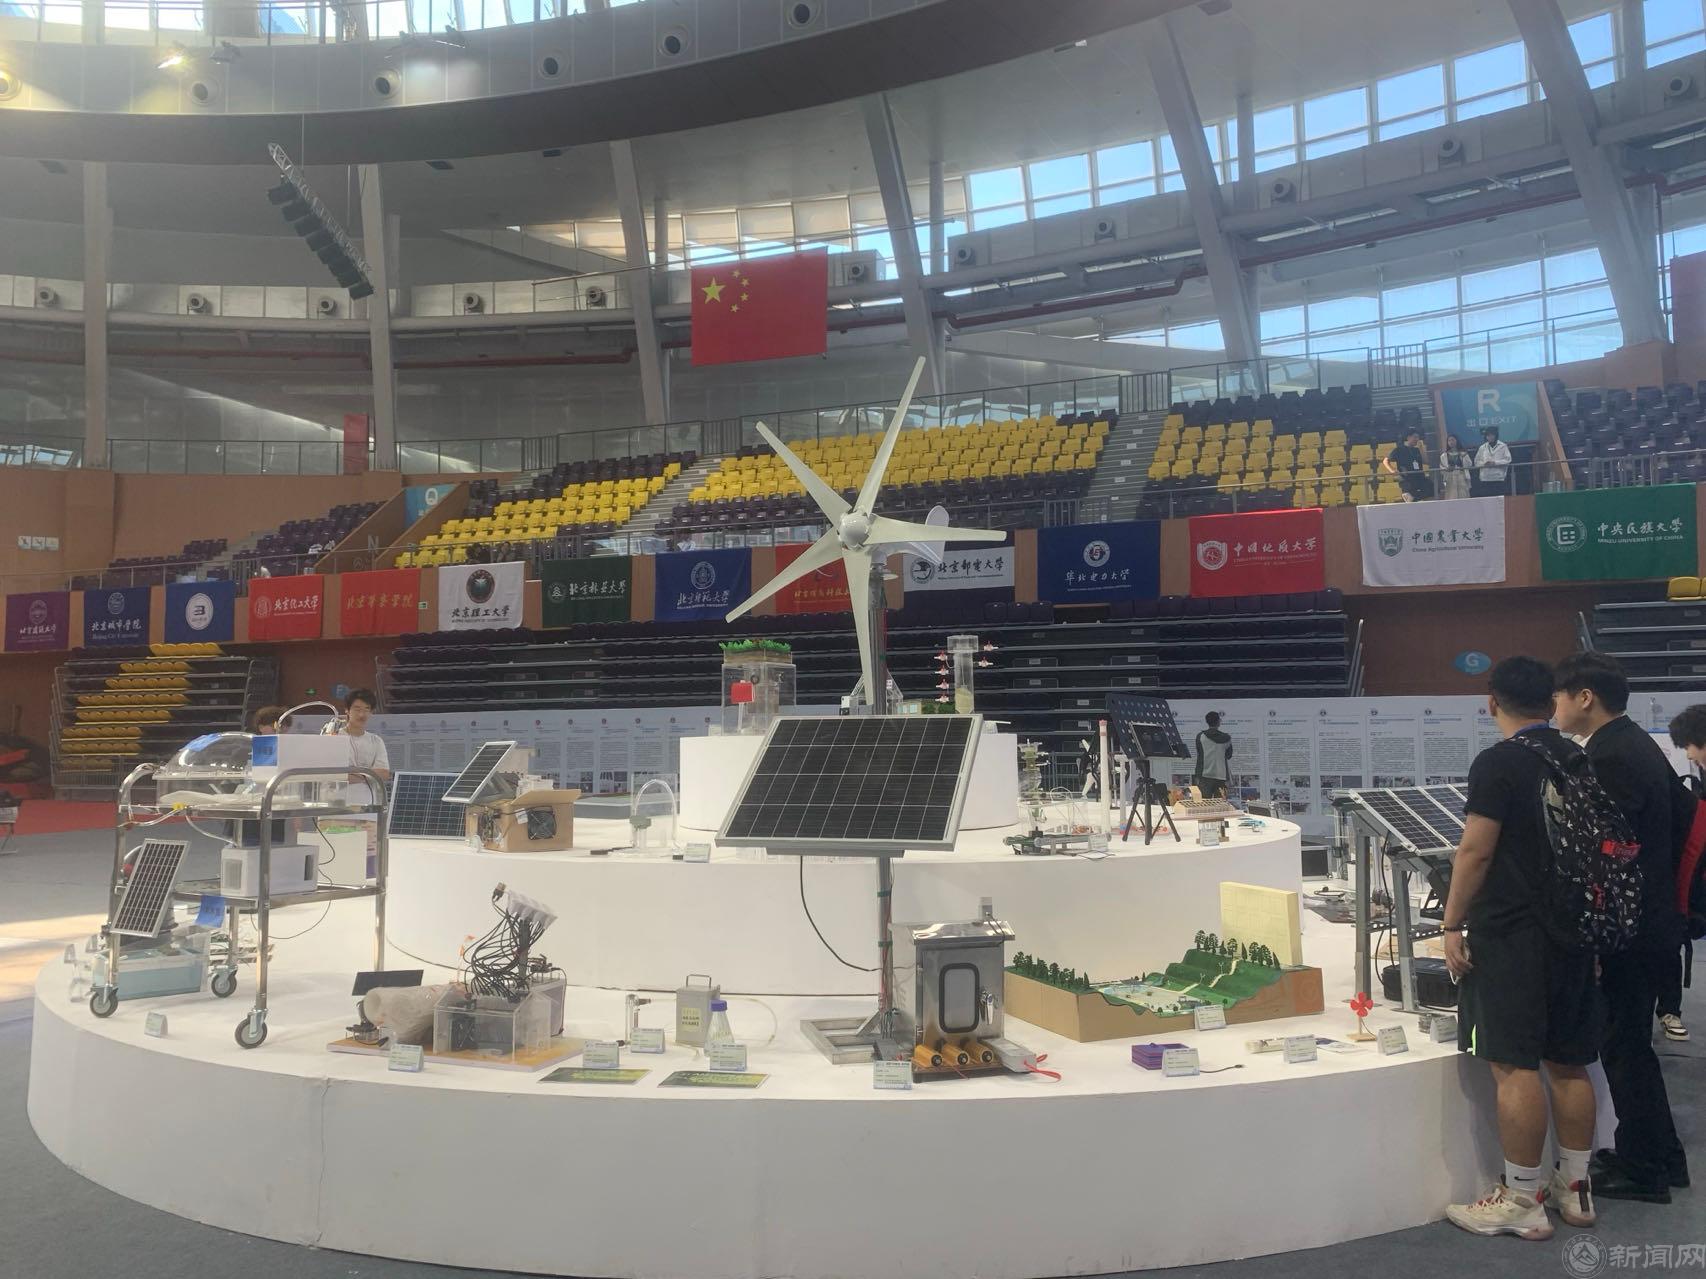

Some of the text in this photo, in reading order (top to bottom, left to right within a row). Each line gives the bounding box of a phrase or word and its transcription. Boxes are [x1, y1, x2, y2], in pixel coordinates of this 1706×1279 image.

[1477, 388, 1500, 413] R
[1466, 419, 1488, 427] 出口
[1491, 416, 1517, 425] EXIT
[425, 487, 438, 506] Q
[1465, 652, 1479, 667] G
